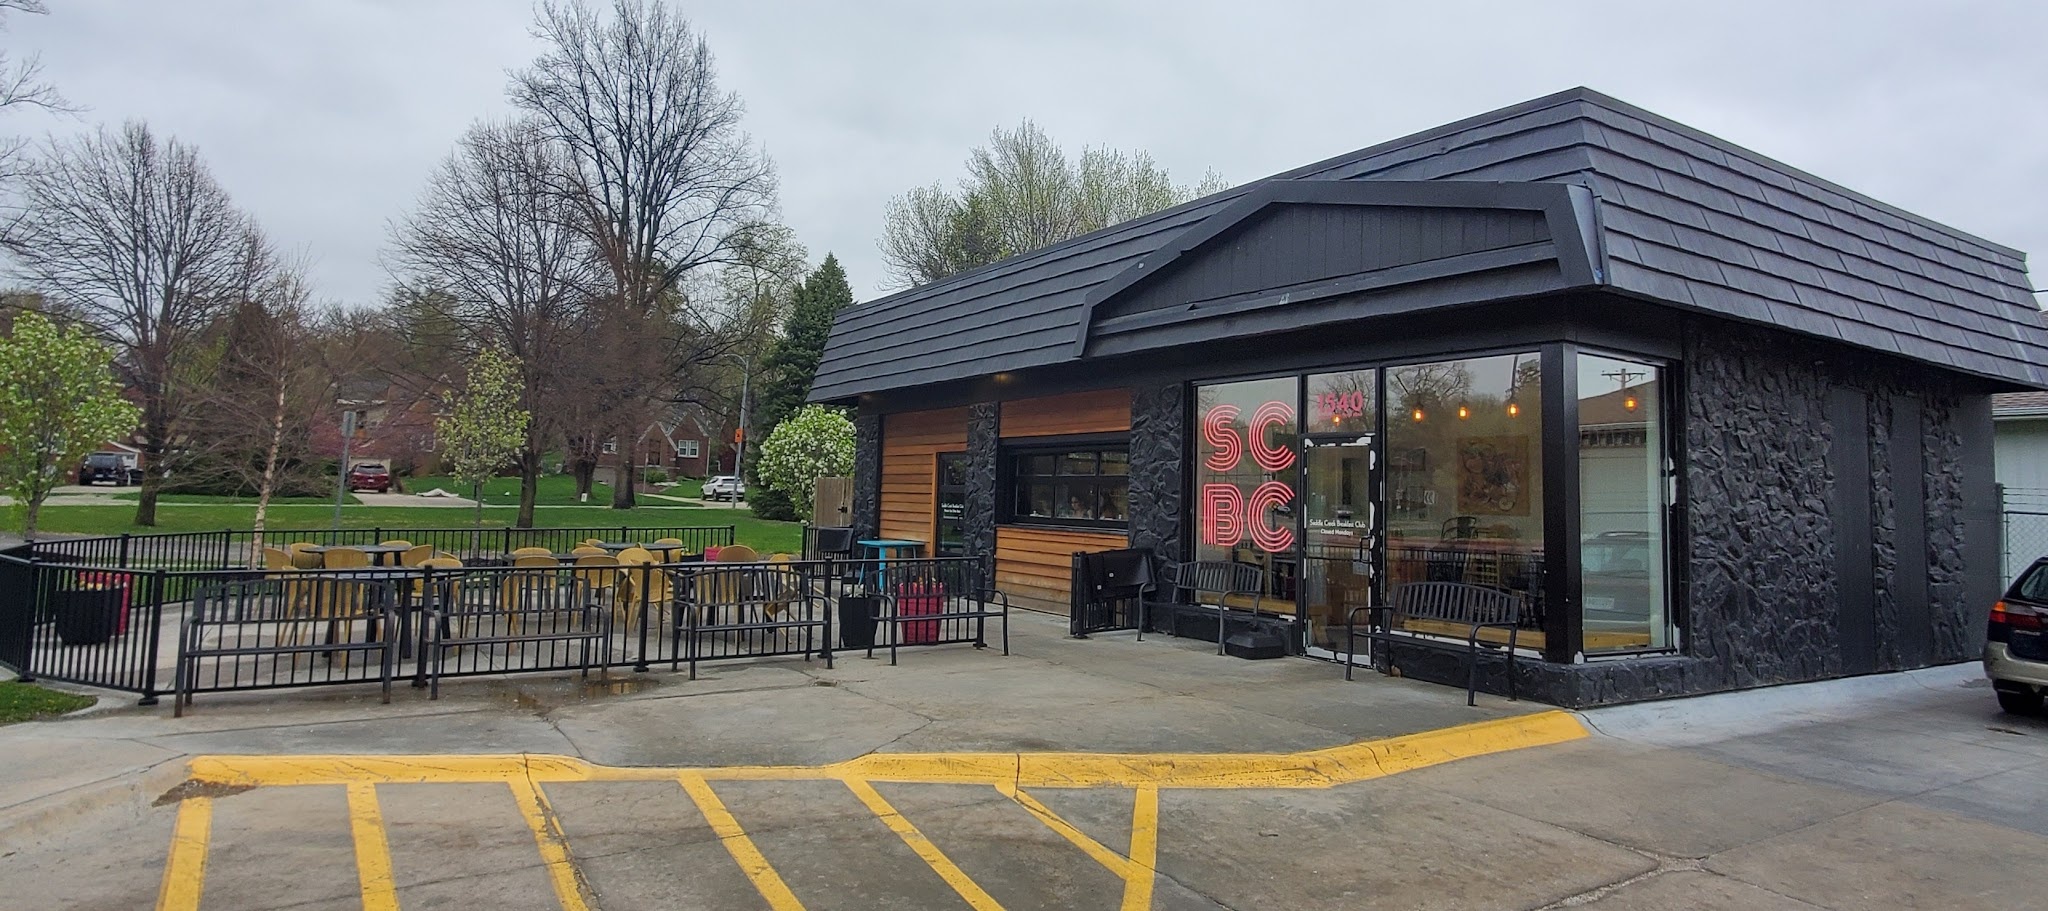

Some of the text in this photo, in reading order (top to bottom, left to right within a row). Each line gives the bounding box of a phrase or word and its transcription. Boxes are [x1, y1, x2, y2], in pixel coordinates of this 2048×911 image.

[1203, 401, 1296, 472] SC
[1317, 390, 1364, 415] 1540
[1203, 481, 1296, 552] BC
